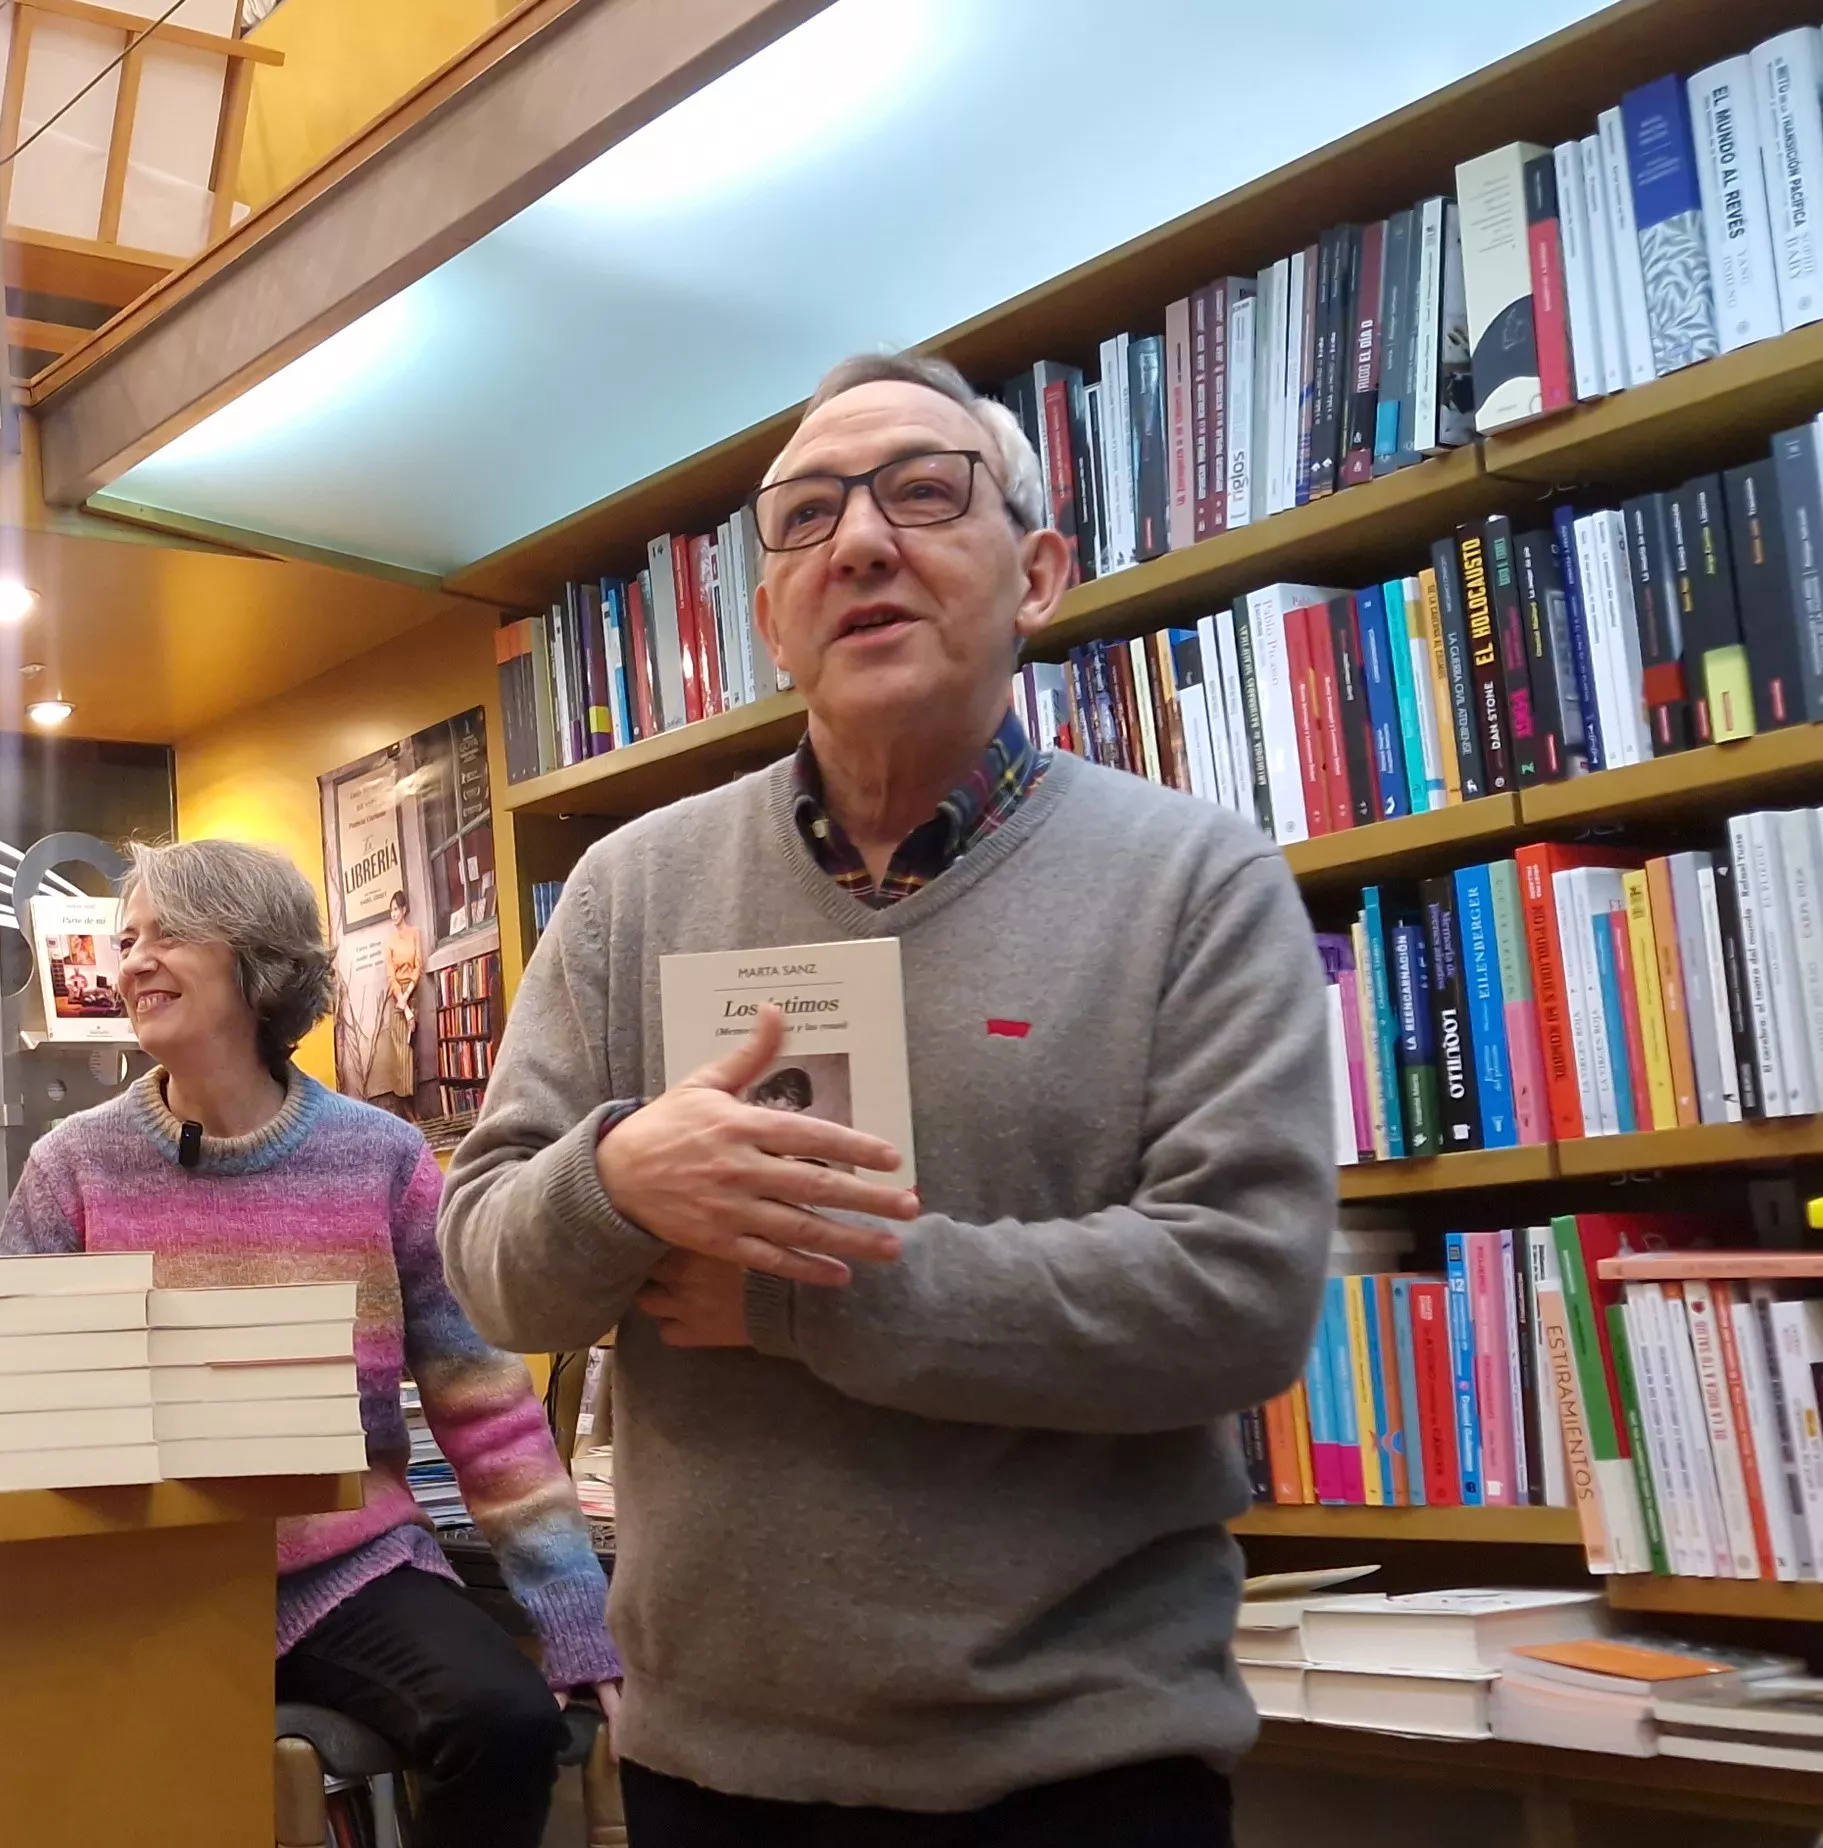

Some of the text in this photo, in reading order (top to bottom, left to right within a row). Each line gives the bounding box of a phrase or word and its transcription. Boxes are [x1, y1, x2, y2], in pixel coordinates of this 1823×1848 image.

[1712, 86, 1746, 240] EL MUNDO AL REVÉS
[1781, 114, 1802, 177] TRANSICIÓN
[1788, 179, 1808, 228] PACÍFICA
[1358, 319, 1374, 362] EL DÍA D
[1228, 451, 1249, 502] riglos
[1461, 537, 1495, 666] EL HOLOCAUSTO
[1447, 632, 1458, 645] LA
[1448, 646, 1462, 682] GUERRA
[1452, 684, 1465, 706] CIVIL
[1484, 681, 1502, 749] DAN STONE
[1454, 708, 1472, 756] ATENIENSE
[344, 838, 398, 894] LIBRERÍA
[1736, 863, 1752, 898] Rafael
[1532, 905, 1545, 924] NO
[1743, 907, 1758, 946] mundo
[1442, 911, 1455, 963] Memoria
[1468, 886, 1490, 999] EILENBERGER
[1745, 948, 1760, 964] del
[738, 963, 818, 979] MARTA SANZ
[1535, 927, 1554, 1003] PUBLIQUEN
[1749, 967, 1764, 1002] teatro
[723, 1000, 759, 1018] Los
[1396, 934, 1417, 1051] LA REENCARNACIÓN
[1754, 1004, 1766, 1013] el
[1572, 1011, 1584, 1037] ROJA
[1440, 1009, 1466, 1099] LOQUILLO
[1548, 1025, 1569, 1081] NOMBRE
[1694, 1320, 1712, 1354] SALUD
[1701, 1356, 1715, 1369] TU
[1546, 1325, 1594, 1501] ESTIRAMIENTOS
[1711, 1411, 1725, 1424] LA
[1714, 1429, 1727, 1440] DE
